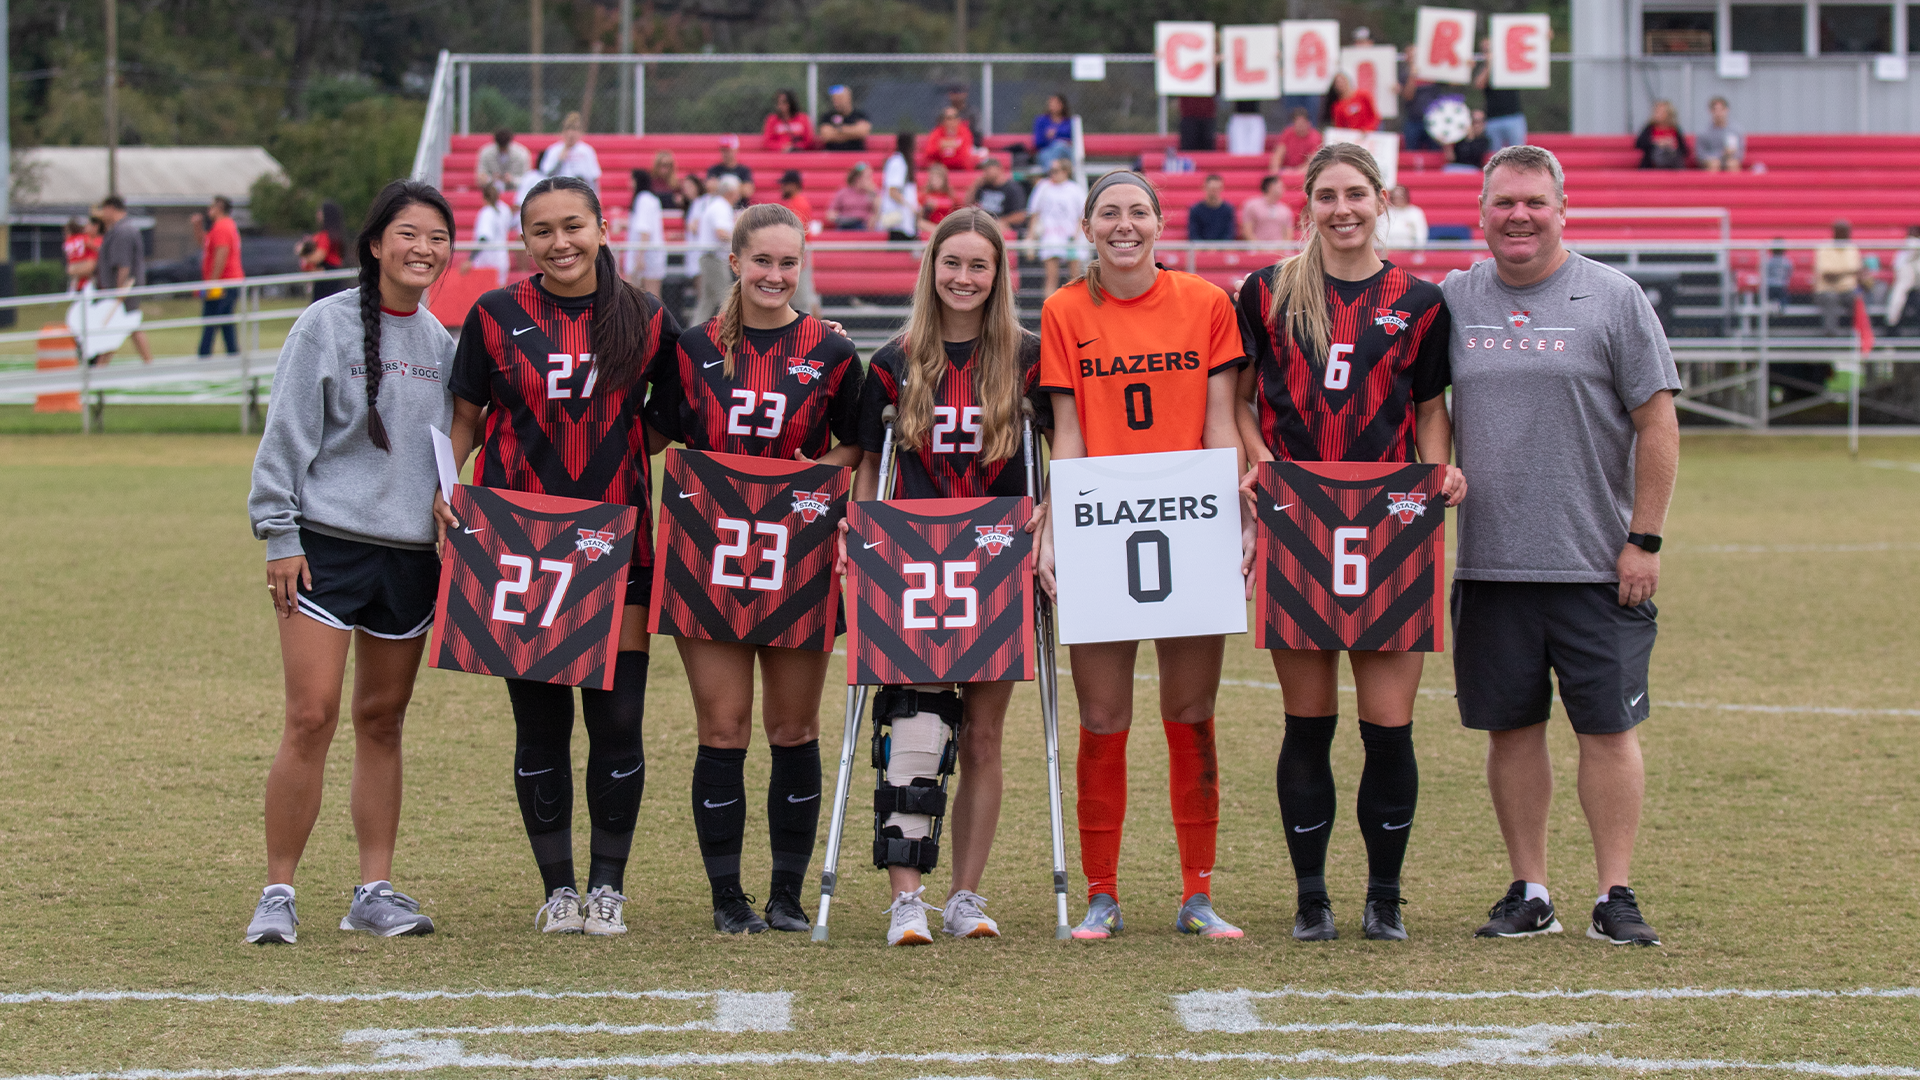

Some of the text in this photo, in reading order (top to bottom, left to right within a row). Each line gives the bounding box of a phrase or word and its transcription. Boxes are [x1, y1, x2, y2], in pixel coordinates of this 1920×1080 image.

[1382, 317, 1404, 327] STATE
[1466, 337, 1565, 352] SOCCER
[351, 362, 398, 376] BLERS
[412, 367, 441, 379] SOCC
[548, 353, 599, 399] 27
[795, 366, 818, 377] STATE
[1079, 351, 1200, 378] BLAZERS
[1324, 343, 1355, 390] 6
[728, 389, 787, 438] 23
[1124, 383, 1153, 430] 0
[932, 406, 983, 454] 25
[799, 501, 823, 511] STATE
[1075, 494, 1218, 527] BLAZERS
[1395, 503, 1419, 511] STATE
[583, 540, 607, 550] STATE
[711, 518, 788, 591] 23
[983, 534, 1007, 543] STATE
[1126, 530, 1172, 603] 0
[1332, 526, 1369, 597] 6
[492, 554, 574, 628] 27
[902, 560, 979, 629] 25
